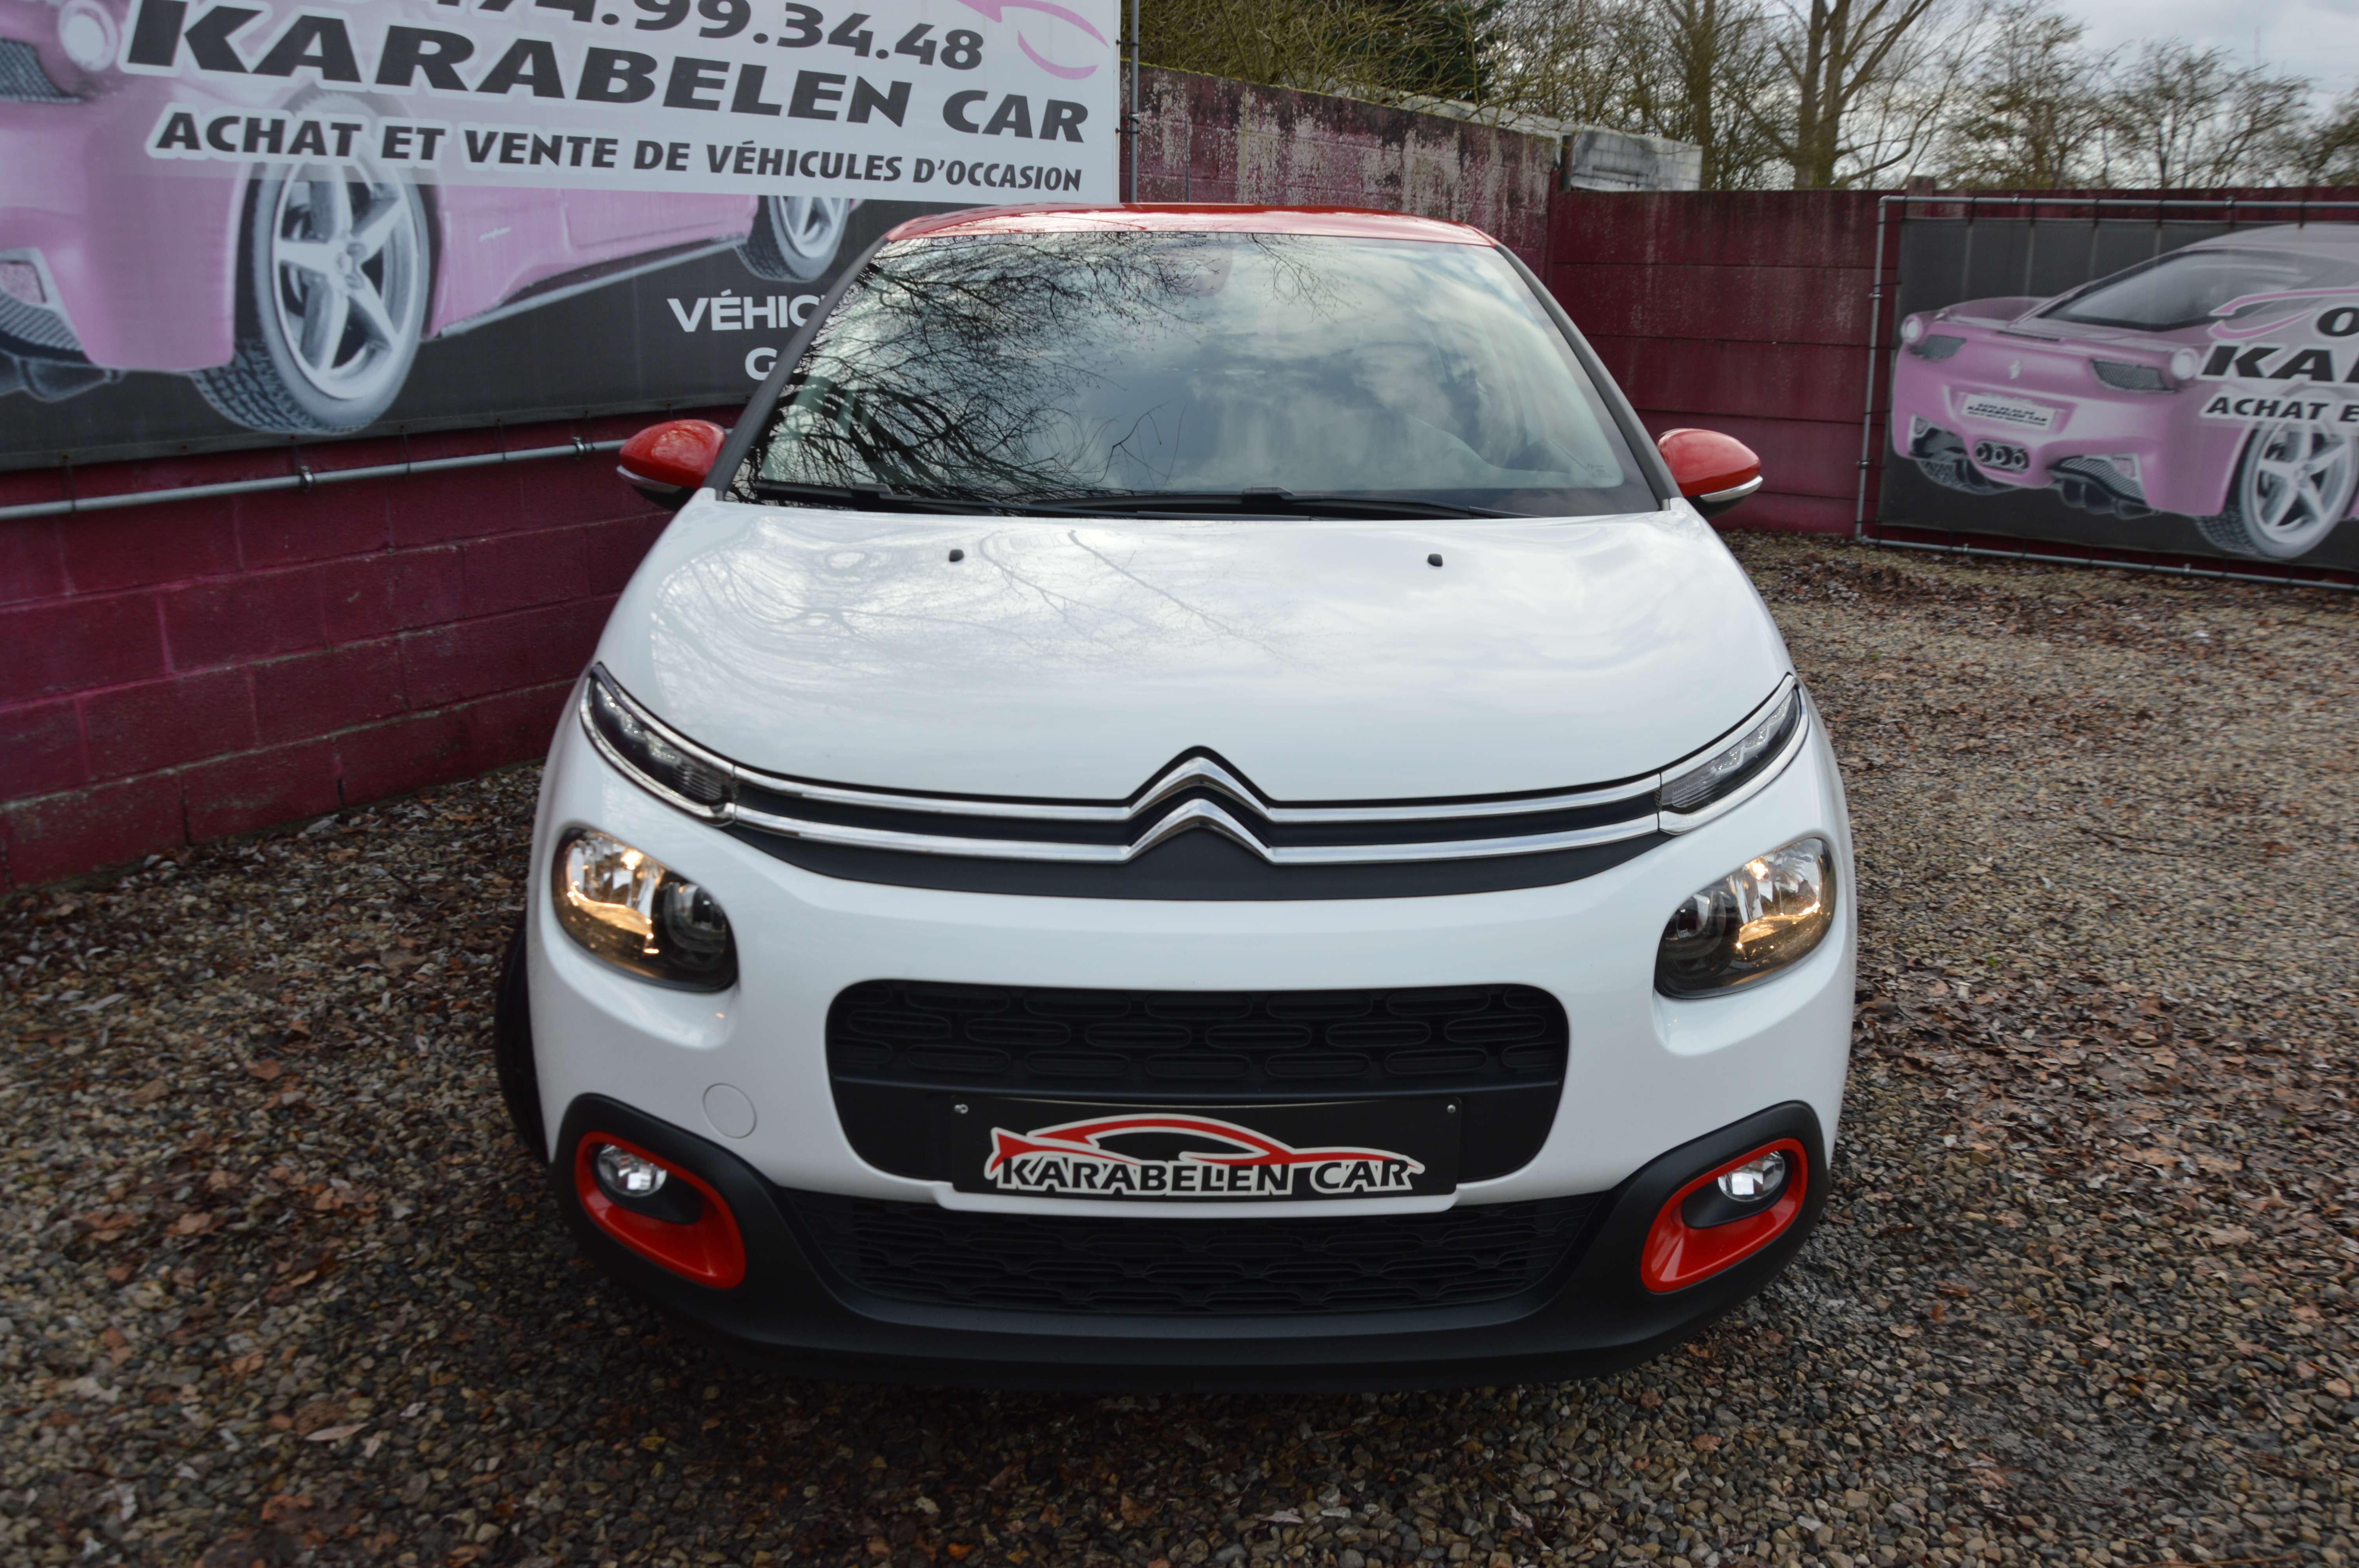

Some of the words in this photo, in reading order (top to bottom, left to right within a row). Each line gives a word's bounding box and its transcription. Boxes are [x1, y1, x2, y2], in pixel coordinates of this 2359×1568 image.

[436, 0, 983, 71] .99.34.48
[127, 0, 912, 128] KARABELEN
[942, 90, 1088, 143] CAR
[156, 112, 362, 156] ACHAT
[381, 125, 445, 160] ET
[465, 130, 619, 168] VENTE
[634, 140, 691, 171] DE
[707, 140, 902, 181] VÉHICULES
[667, 289, 825, 332] VÉHIC
[2201, 345, 2359, 383] KA
[2206, 397, 2330, 420] ACHAT
[1003, 1158, 1290, 1192] KARABELEN
[1314, 1159, 1408, 1189] CAR
